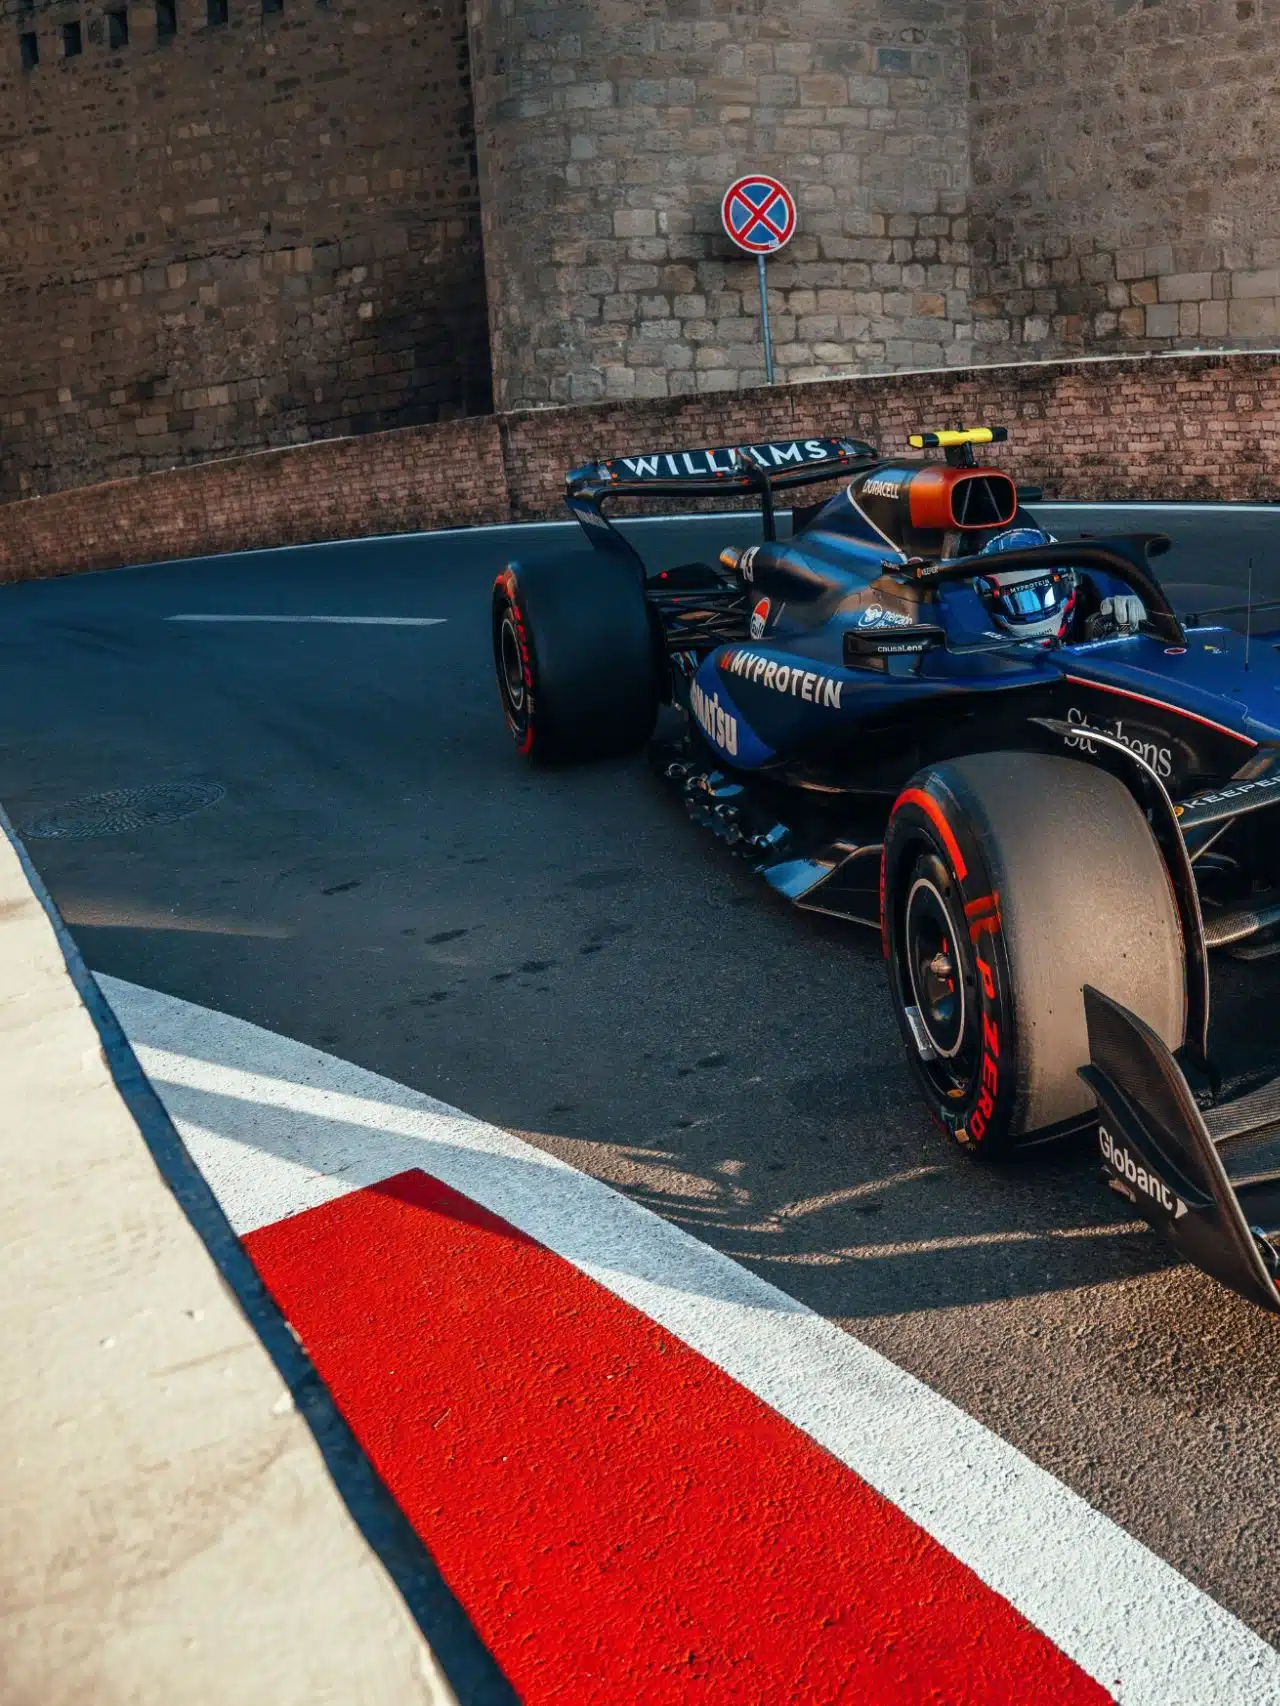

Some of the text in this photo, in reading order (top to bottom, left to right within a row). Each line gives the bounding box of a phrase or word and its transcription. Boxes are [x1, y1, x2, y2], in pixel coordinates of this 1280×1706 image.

[862, 479, 900, 499] DURACELL
[1010, 578, 1050, 594] MYPROTEIN
[730, 649, 844, 709] MYPROTEIN
[1064, 707, 1172, 778] Stehens
